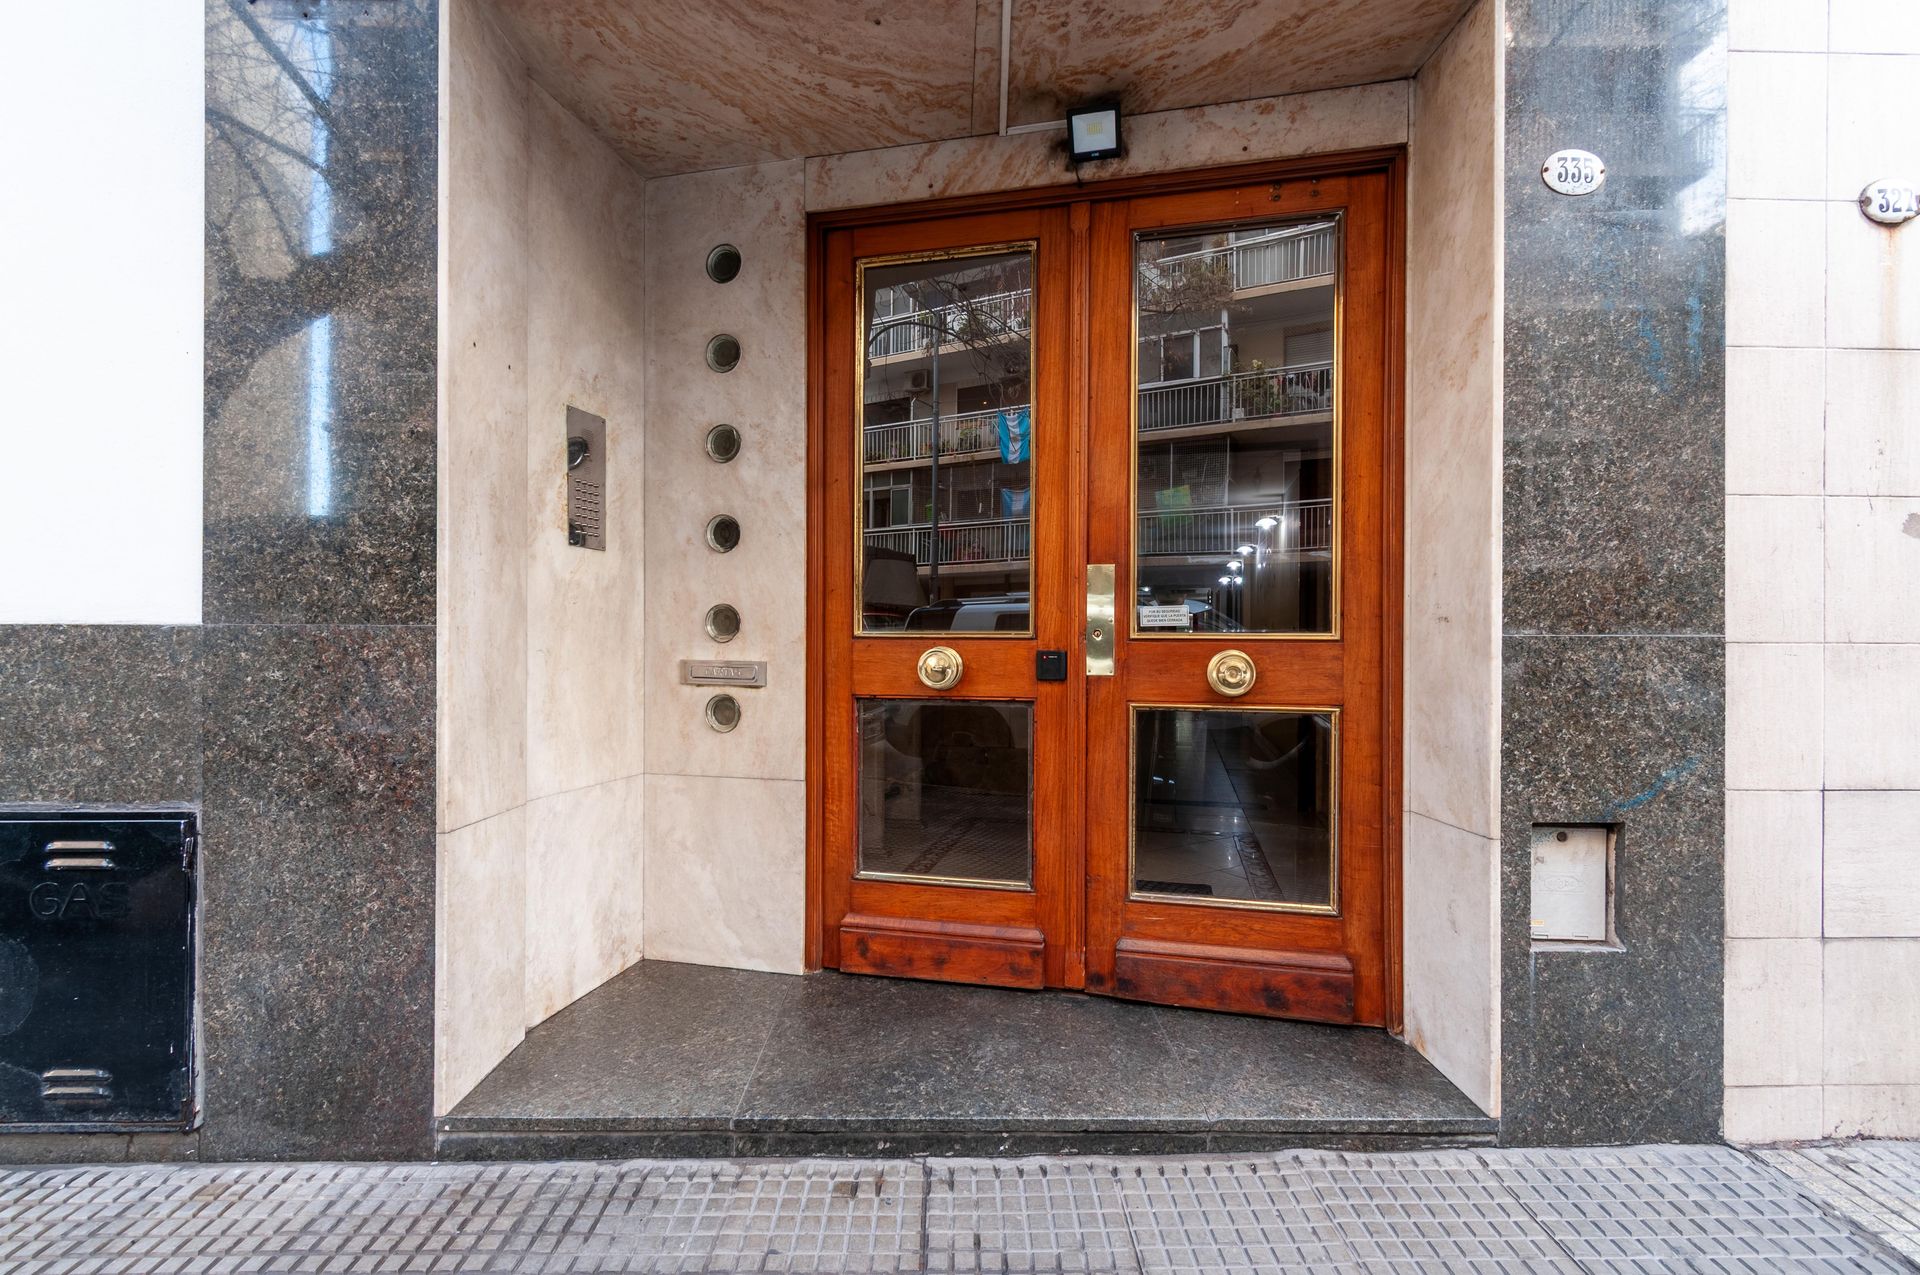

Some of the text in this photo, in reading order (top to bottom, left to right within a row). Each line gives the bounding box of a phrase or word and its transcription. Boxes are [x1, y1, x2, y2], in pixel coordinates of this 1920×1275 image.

[1556, 156, 1594, 184] 335
[1877, 187, 1914, 213] 327
[29, 881, 129, 919] GAS
